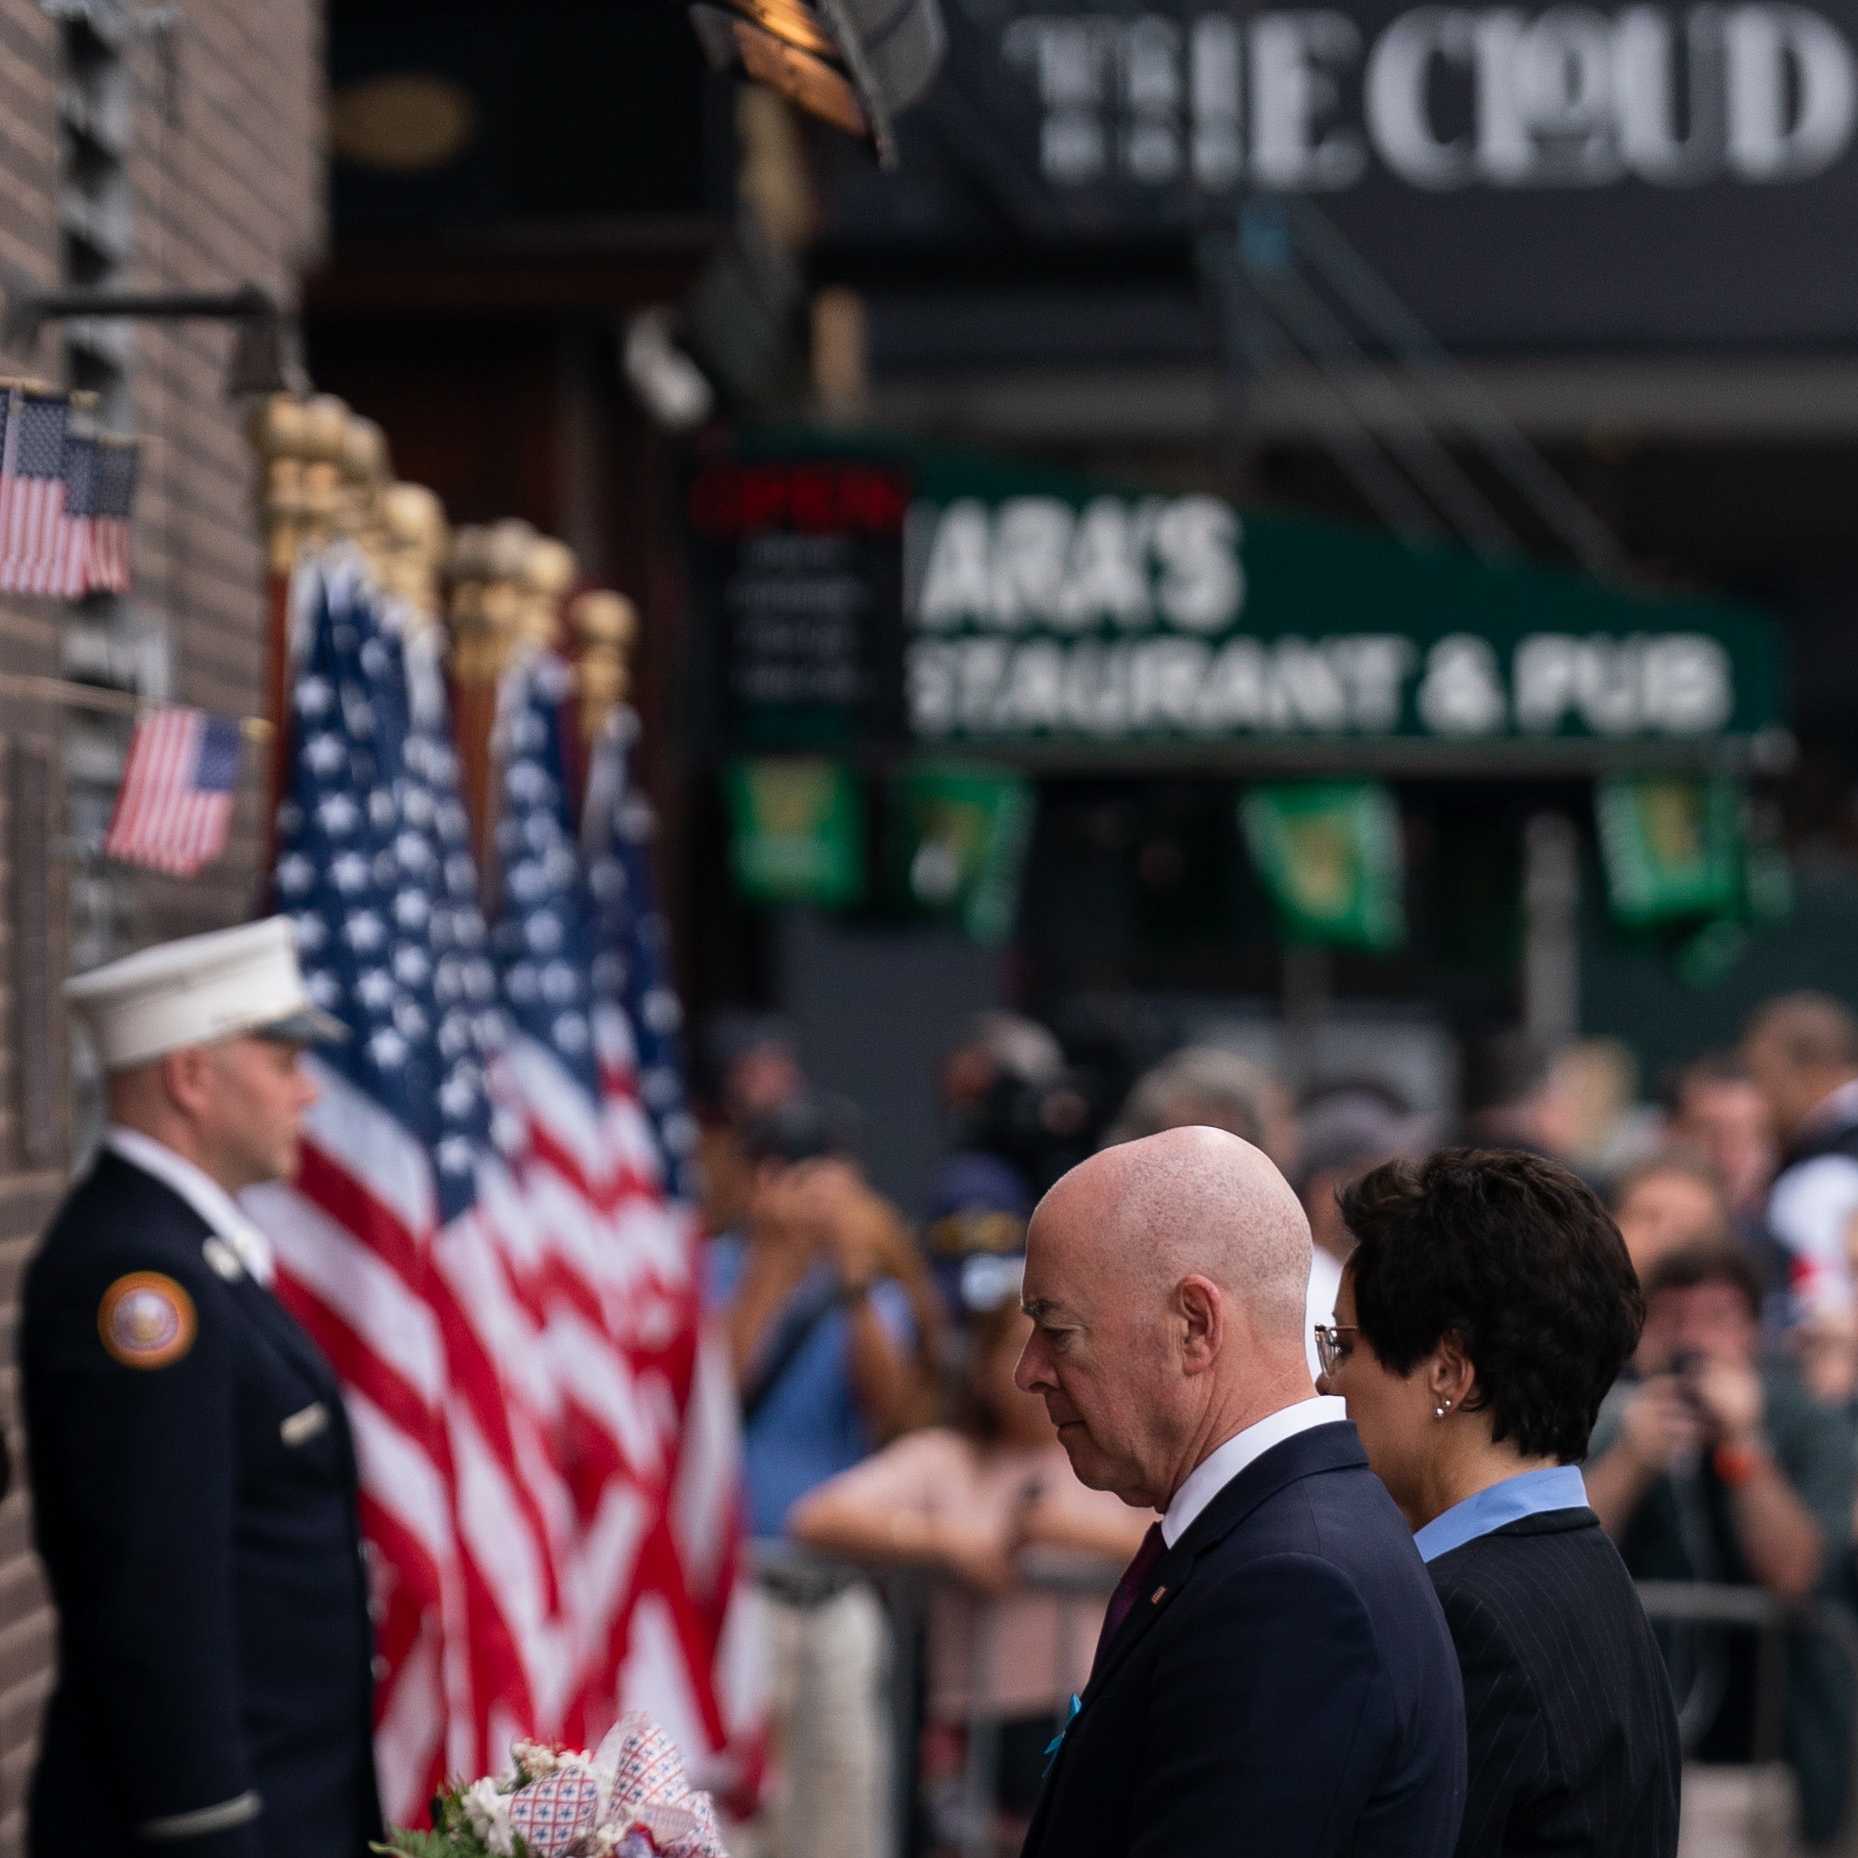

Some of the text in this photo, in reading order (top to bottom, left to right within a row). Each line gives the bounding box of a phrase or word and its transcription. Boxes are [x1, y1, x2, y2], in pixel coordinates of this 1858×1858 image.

[1001, 8, 1367, 190] THE
[1365, 1, 1858, 190] CLOUD
[1416, 632, 1506, 736] &
[1513, 632, 1736, 736] PUB
